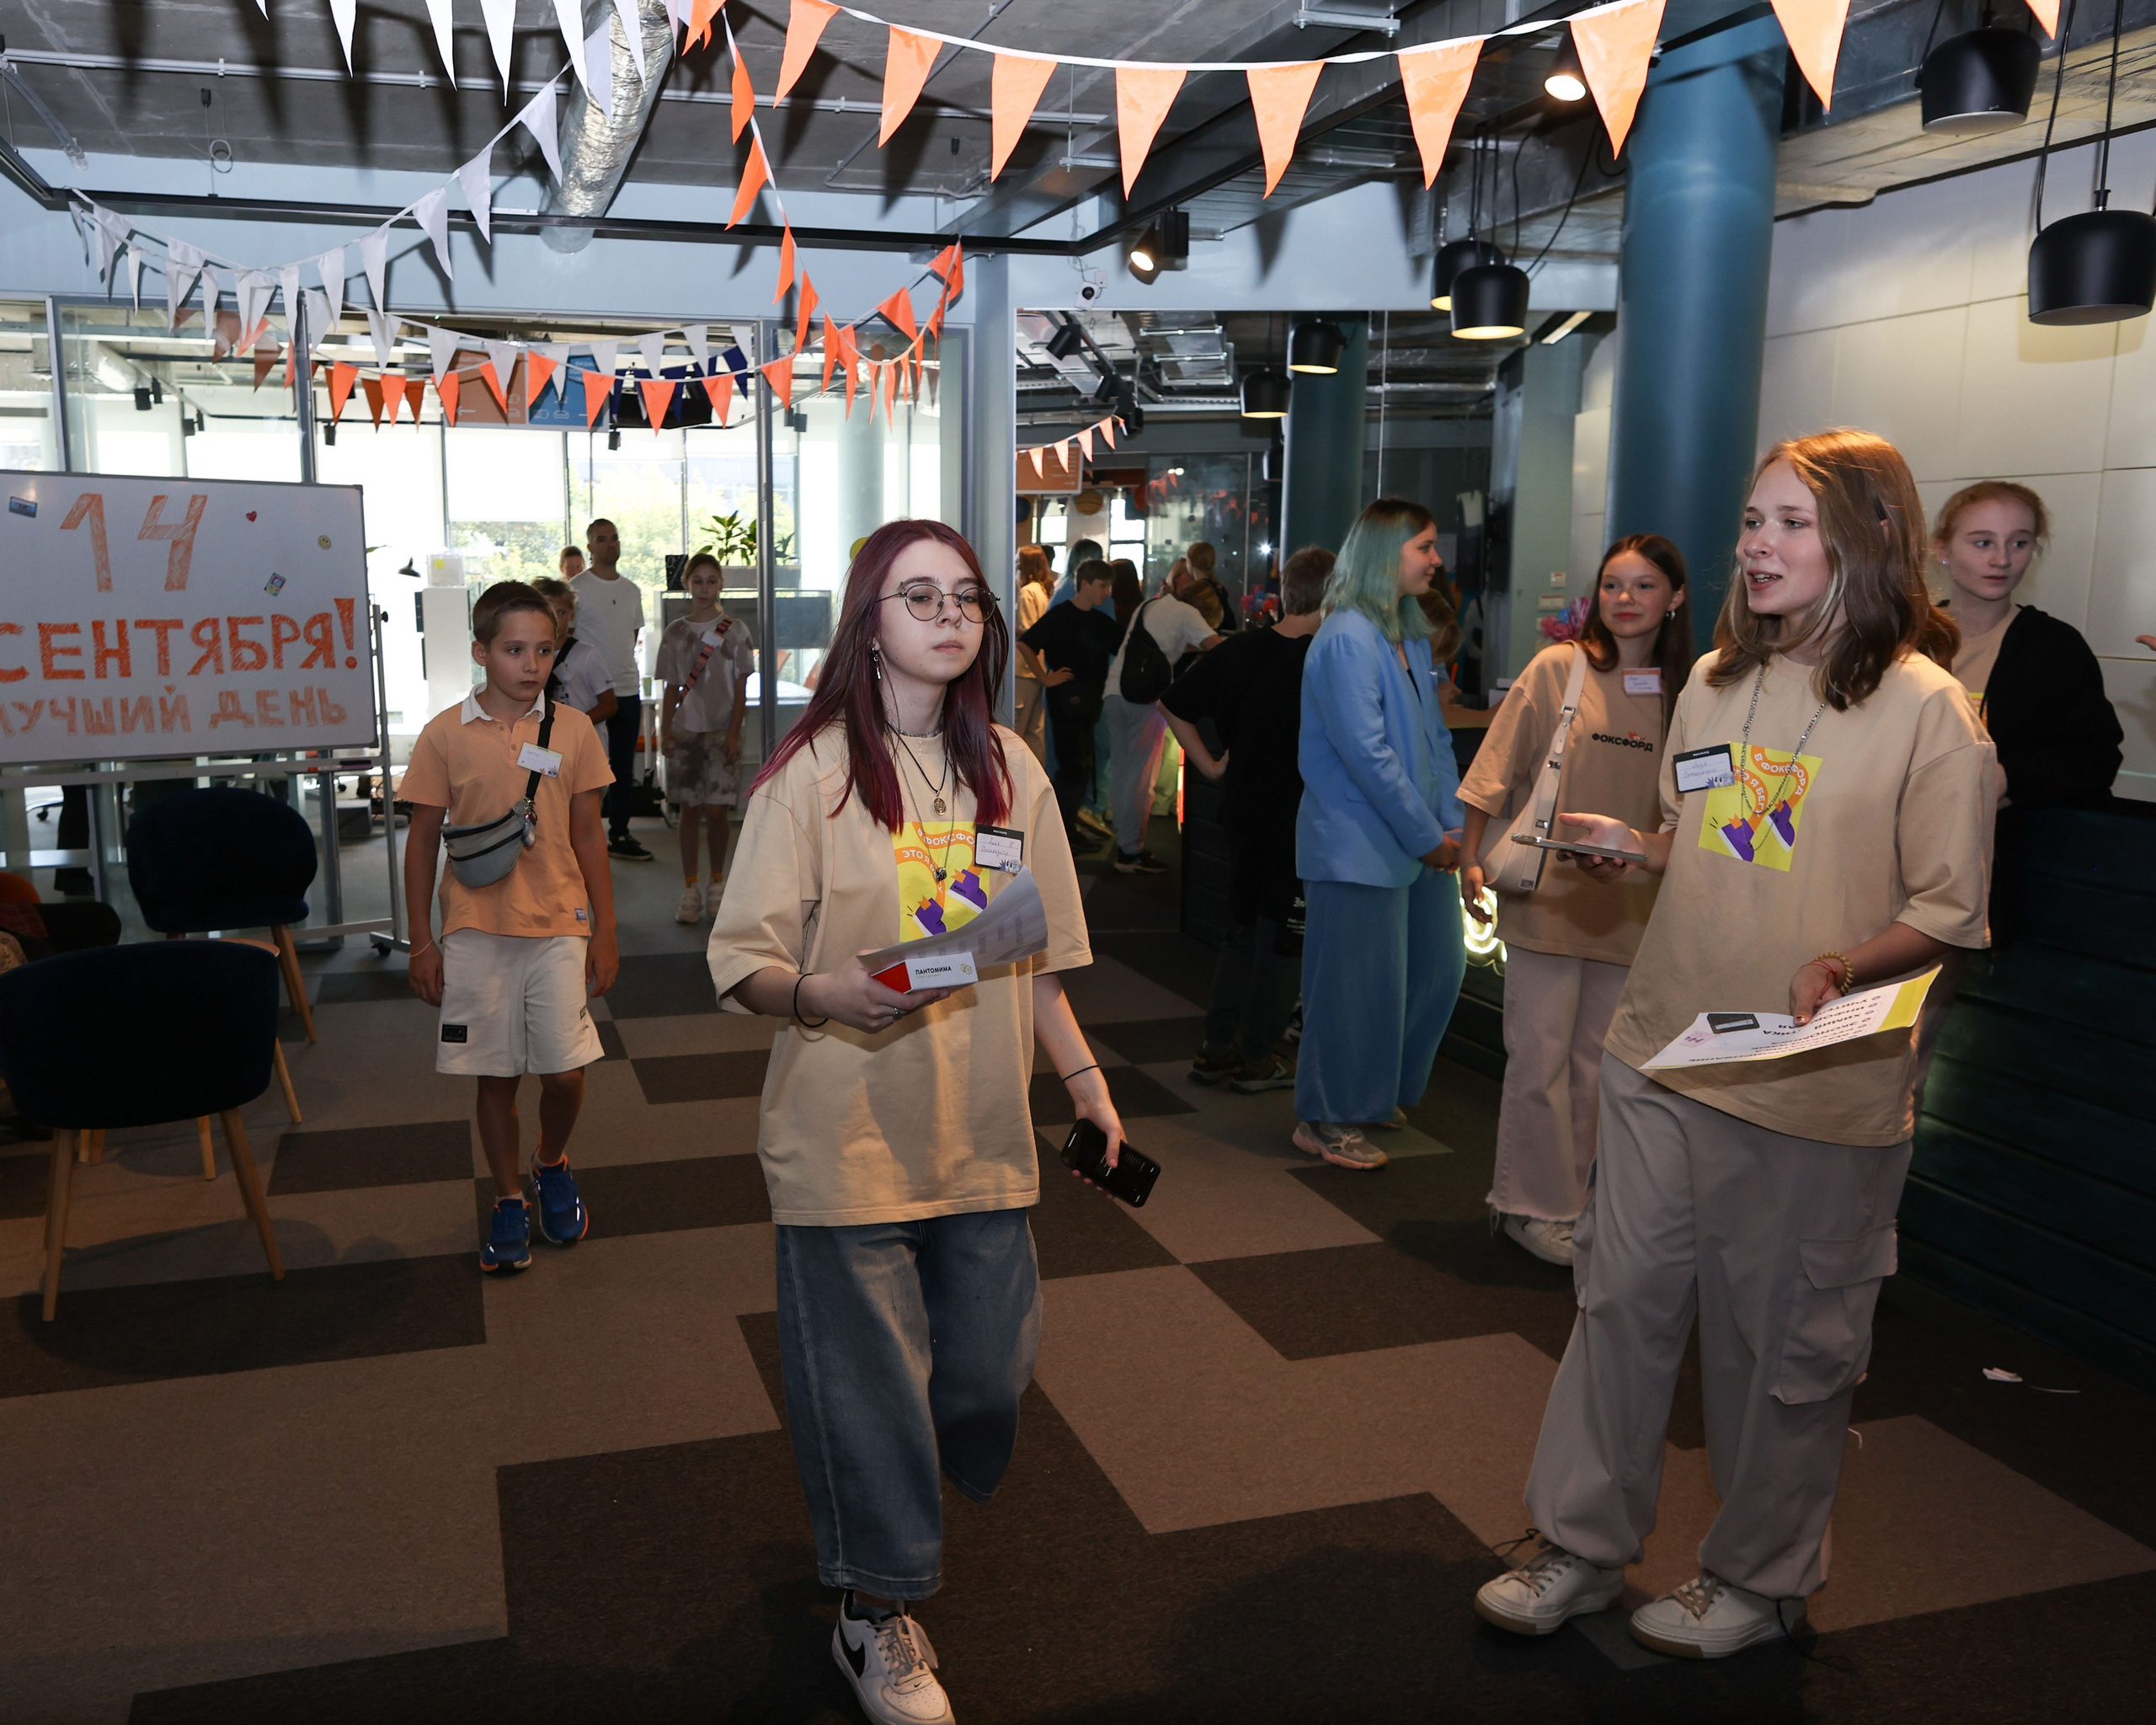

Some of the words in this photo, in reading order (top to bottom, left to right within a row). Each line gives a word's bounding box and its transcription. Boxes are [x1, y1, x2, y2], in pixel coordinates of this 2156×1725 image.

[60, 493, 208, 592] 14
[0, 597, 358, 684] СЕНТЯБРЯ!
[208, 686, 348, 730] ДЕНЬ
[1592, 733, 1653, 752] ФОКСФОРД
[923, 832, 975, 846] ФОКСФО
[902, 849, 924, 859] ЭТО
[915, 966, 952, 975] ПАНТОМИМА
[1815, 1013, 1861, 1029] ХИМИЯ
